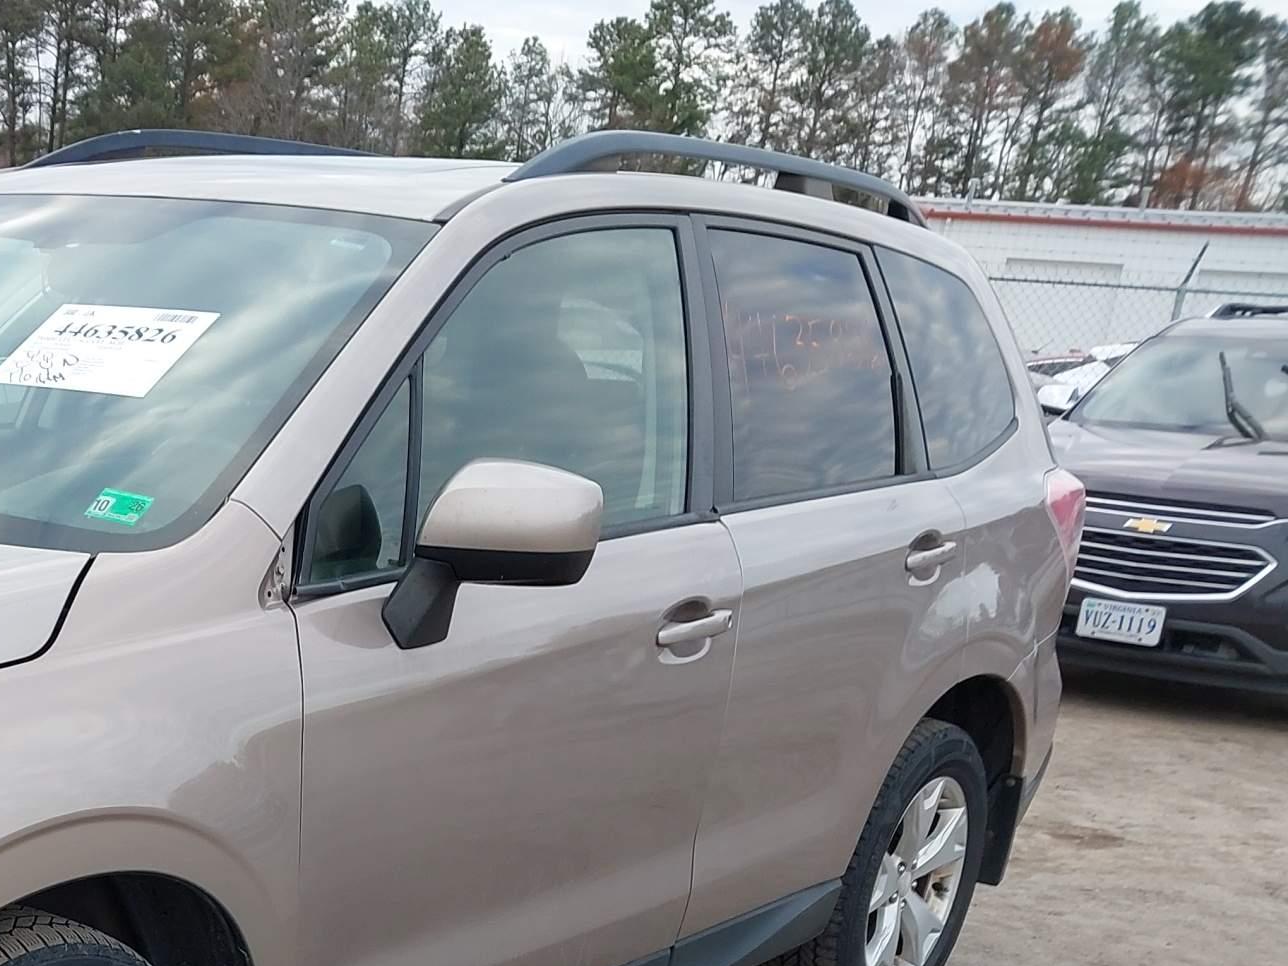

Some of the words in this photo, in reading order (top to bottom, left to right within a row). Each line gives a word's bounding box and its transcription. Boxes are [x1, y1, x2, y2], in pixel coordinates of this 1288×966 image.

[54, 321, 179, 344] 44635826
[92, 499, 110, 512] 10
[1103, 603, 1142, 616] VIRGINIA
